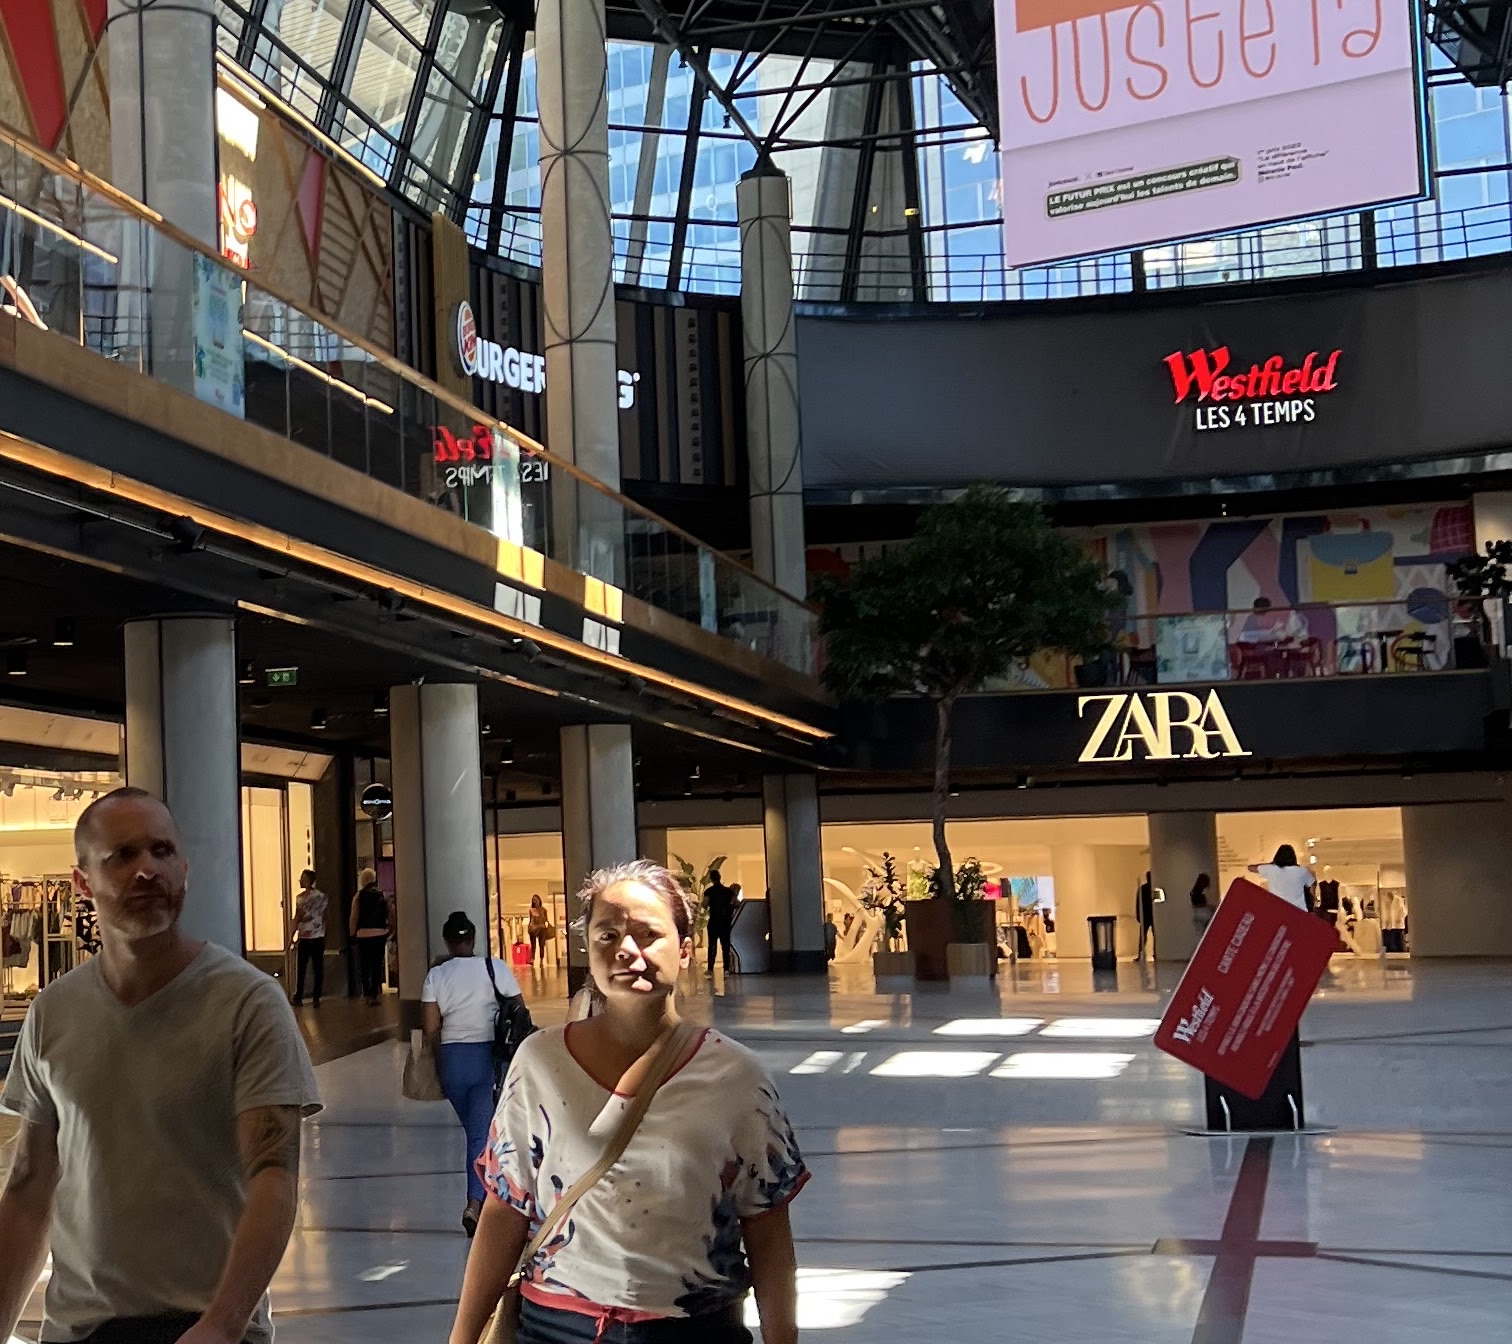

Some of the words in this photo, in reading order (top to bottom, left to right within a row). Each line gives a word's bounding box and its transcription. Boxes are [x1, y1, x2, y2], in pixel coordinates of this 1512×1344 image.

[1048, 195, 1061, 205] LE
[476, 337, 547, 393] URGER
[1163, 346, 1342, 404] Westfield
[1196, 406, 1231, 430] LES
[1235, 405, 1247, 426] 4
[1250, 399, 1315, 425] TEMPS
[1078, 689, 1253, 762] ZARA
